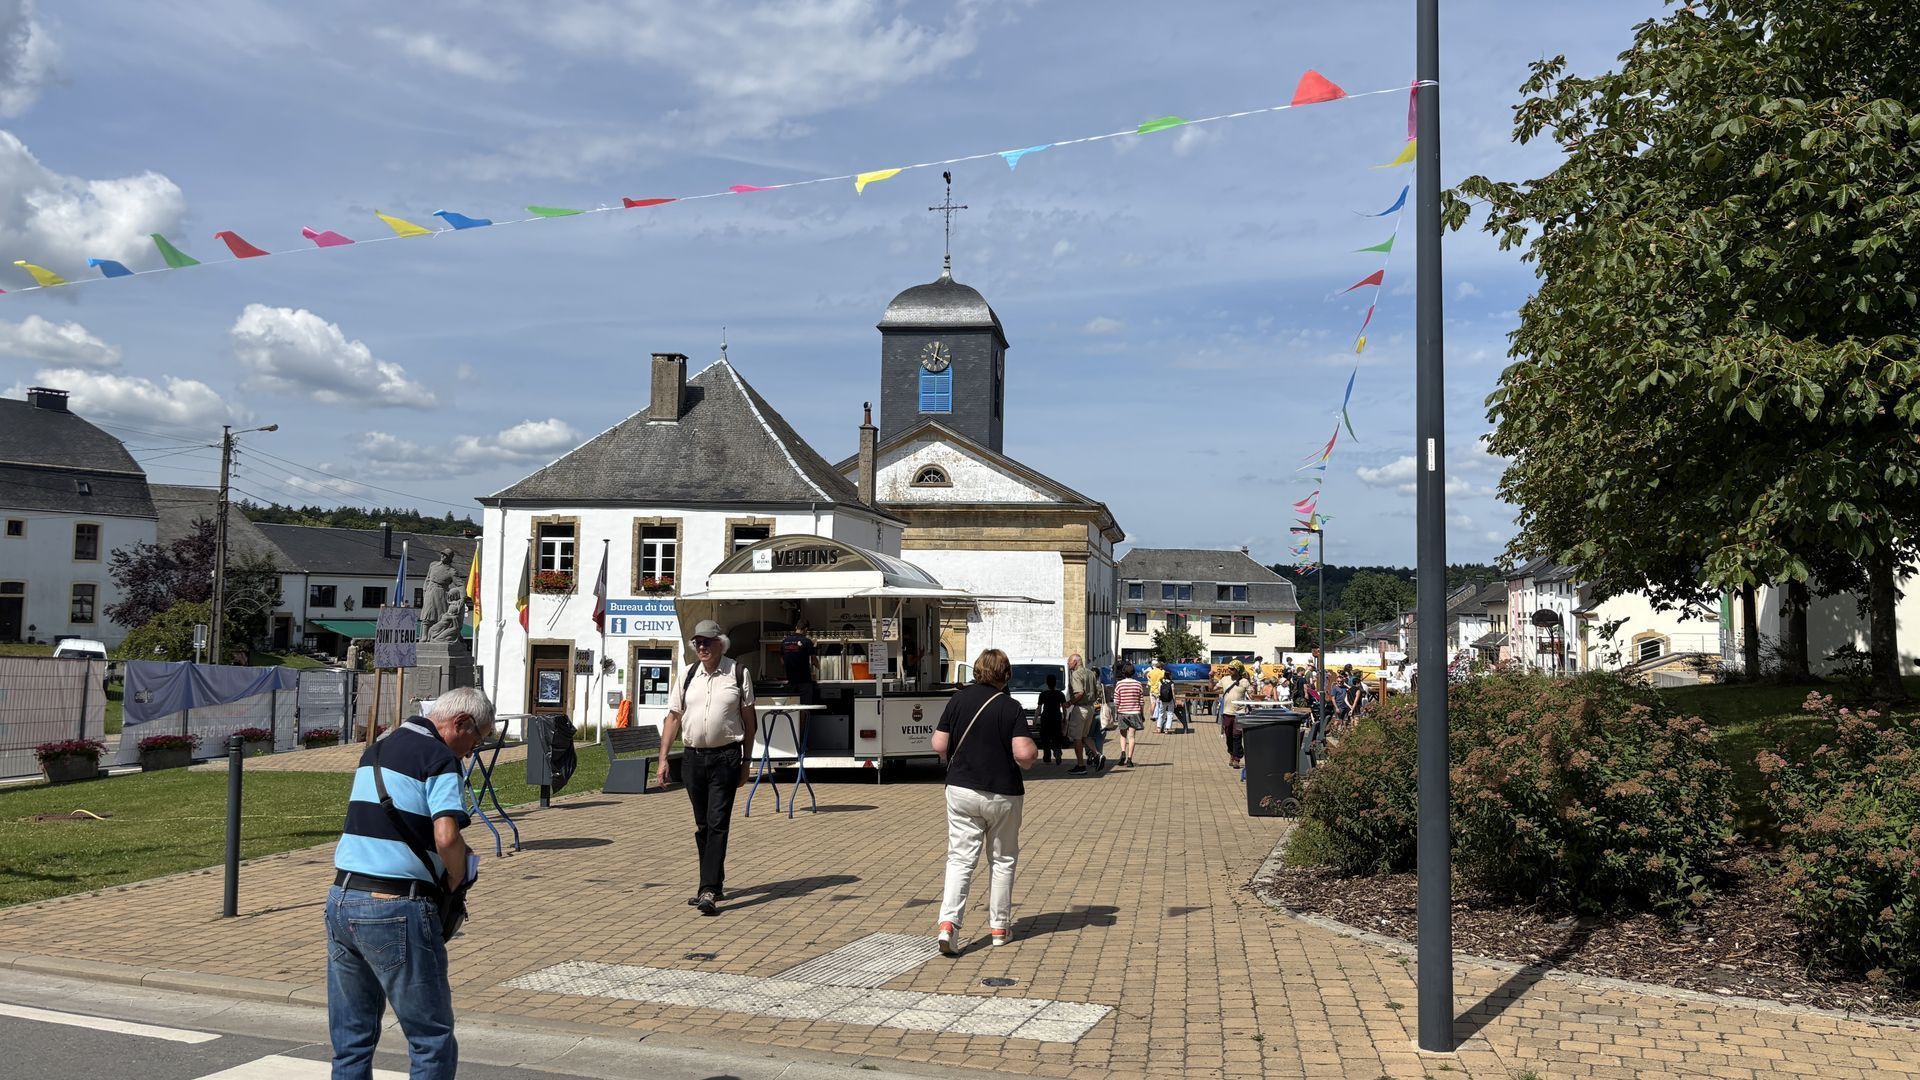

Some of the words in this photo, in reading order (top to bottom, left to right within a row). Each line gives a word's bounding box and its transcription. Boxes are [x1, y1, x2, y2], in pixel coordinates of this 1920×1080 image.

[774, 549, 838, 565] VELTINS
[610, 602, 643, 611] Bureau
[645, 602, 657, 611] du
[634, 620, 673, 631] CHINY
[394, 629, 416, 644] D'EAU
[901, 725, 933, 735] VELTINS
